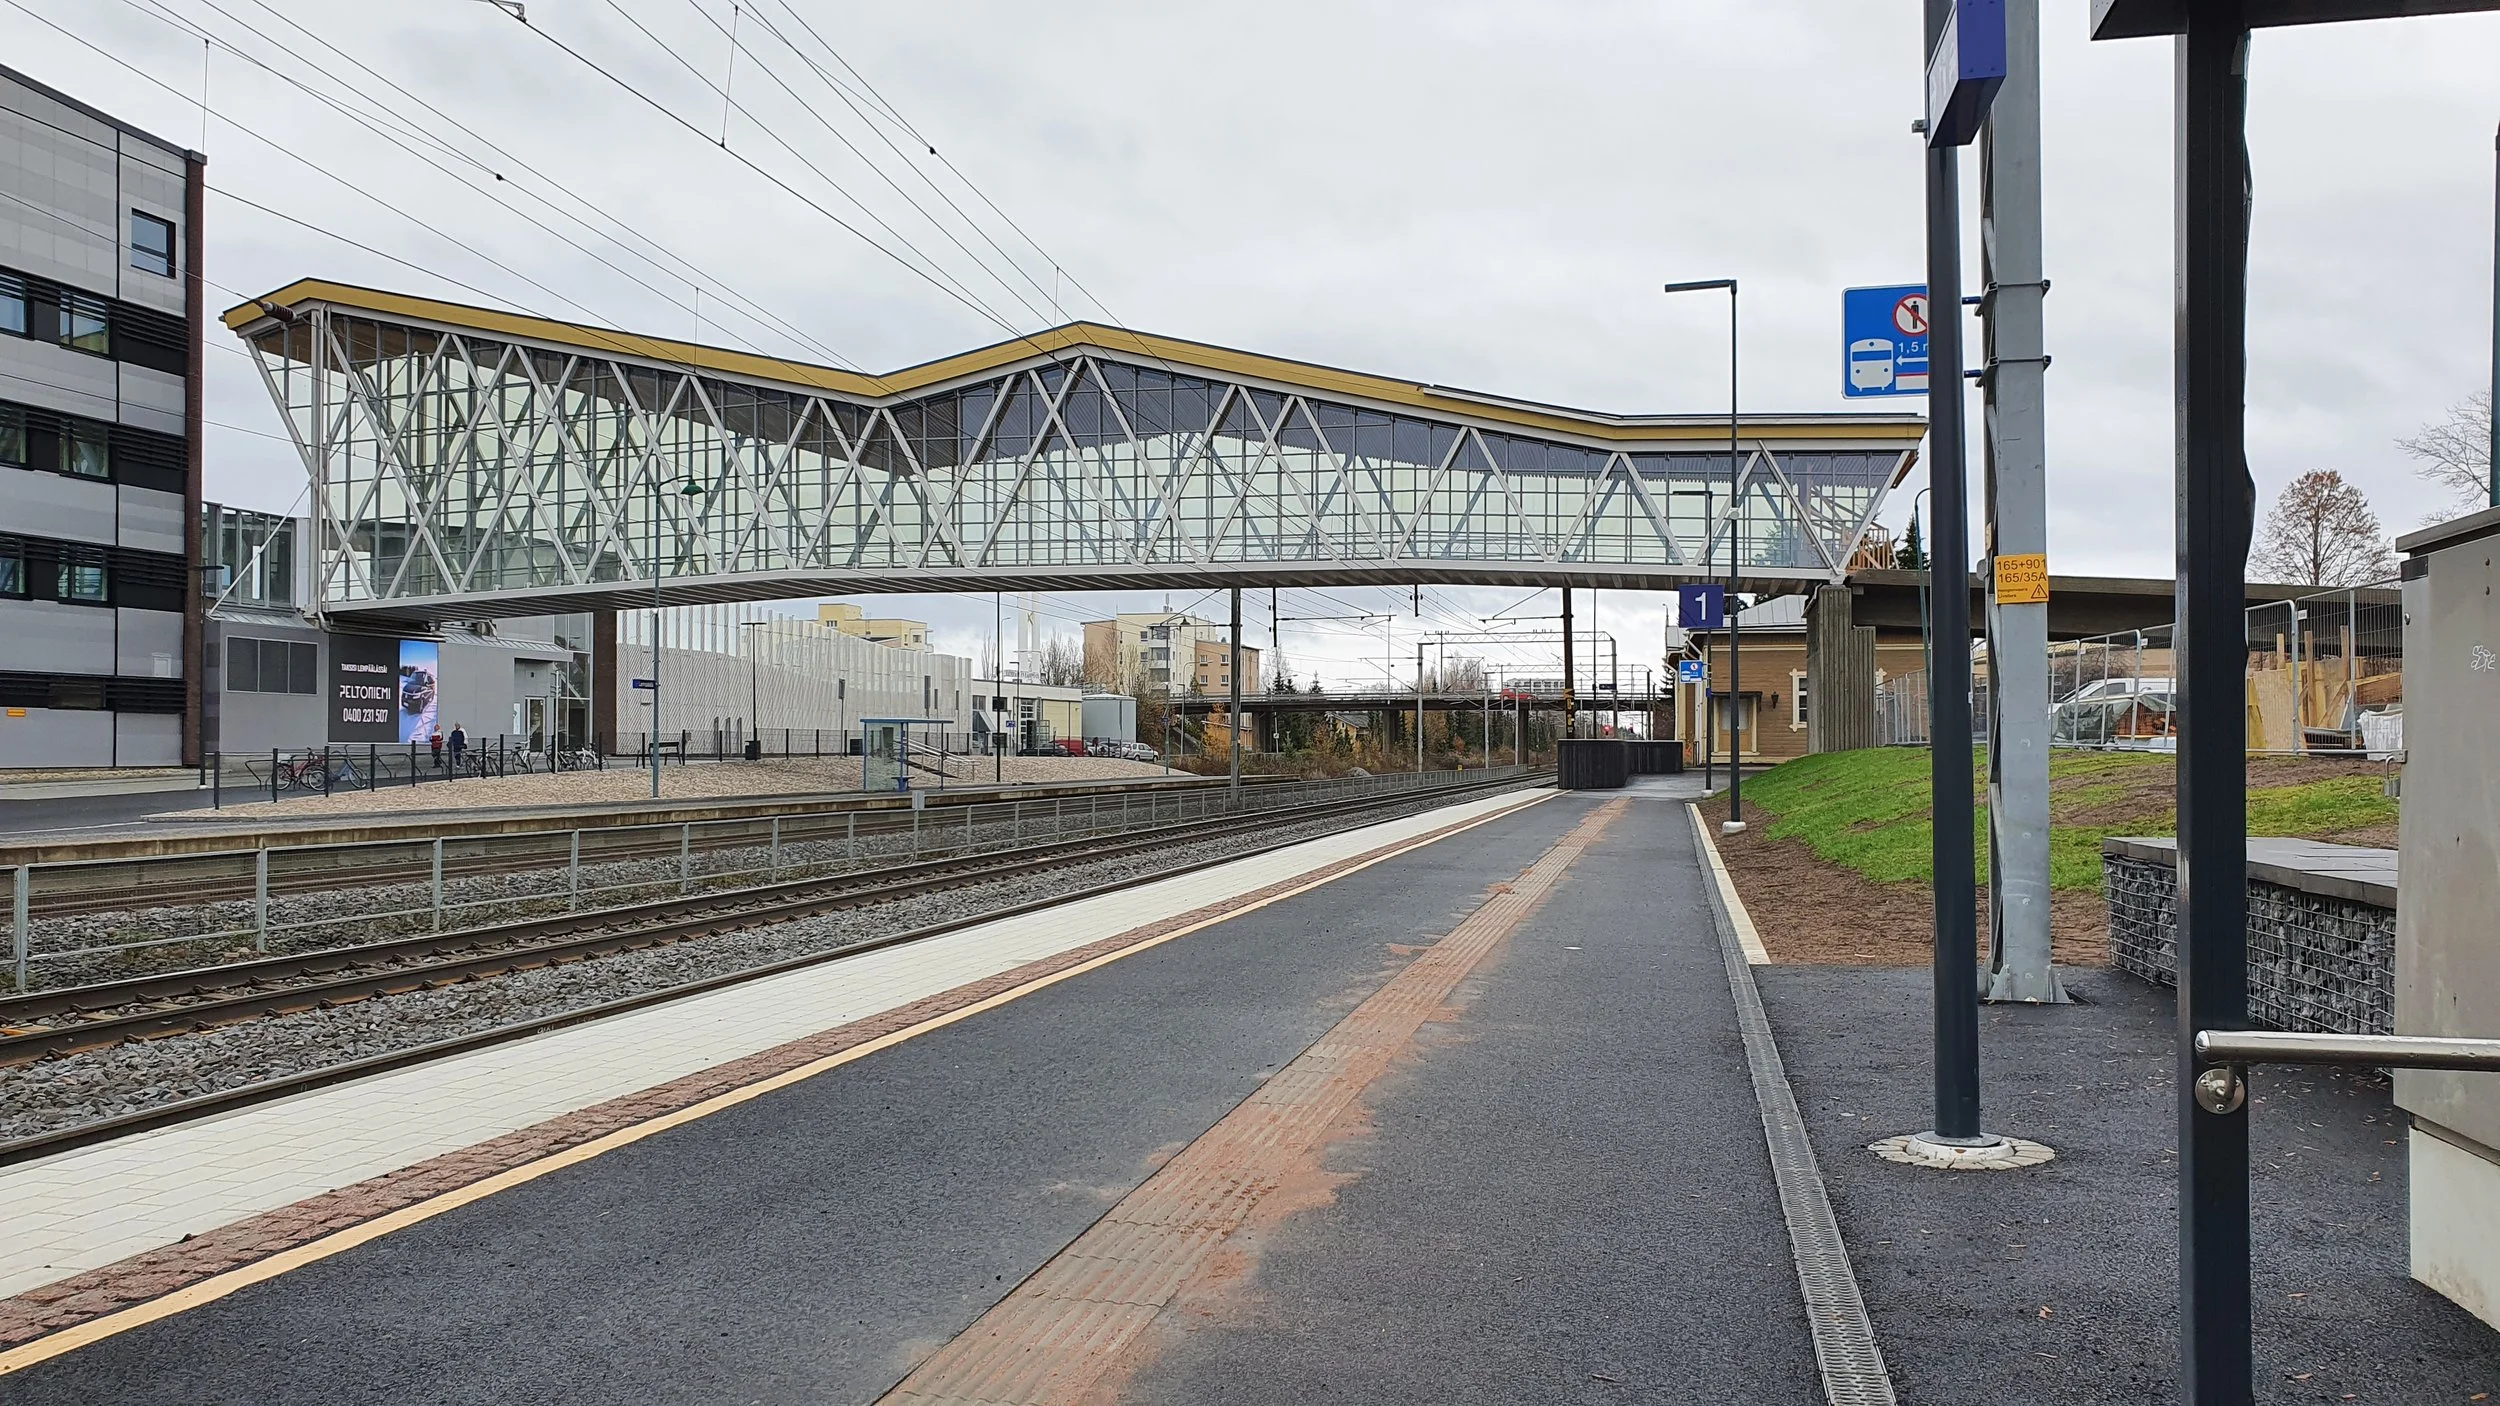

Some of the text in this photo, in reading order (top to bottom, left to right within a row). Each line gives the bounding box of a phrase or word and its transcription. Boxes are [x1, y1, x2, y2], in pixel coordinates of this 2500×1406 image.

[1898, 341, 1919, 354] 1,5
[1999, 572, 2047, 583] 165/35A
[1695, 592, 1706, 620] 1
[340, 685, 391, 700] PELTONIEMI
[343, 708, 388, 723] 0400 231 507
